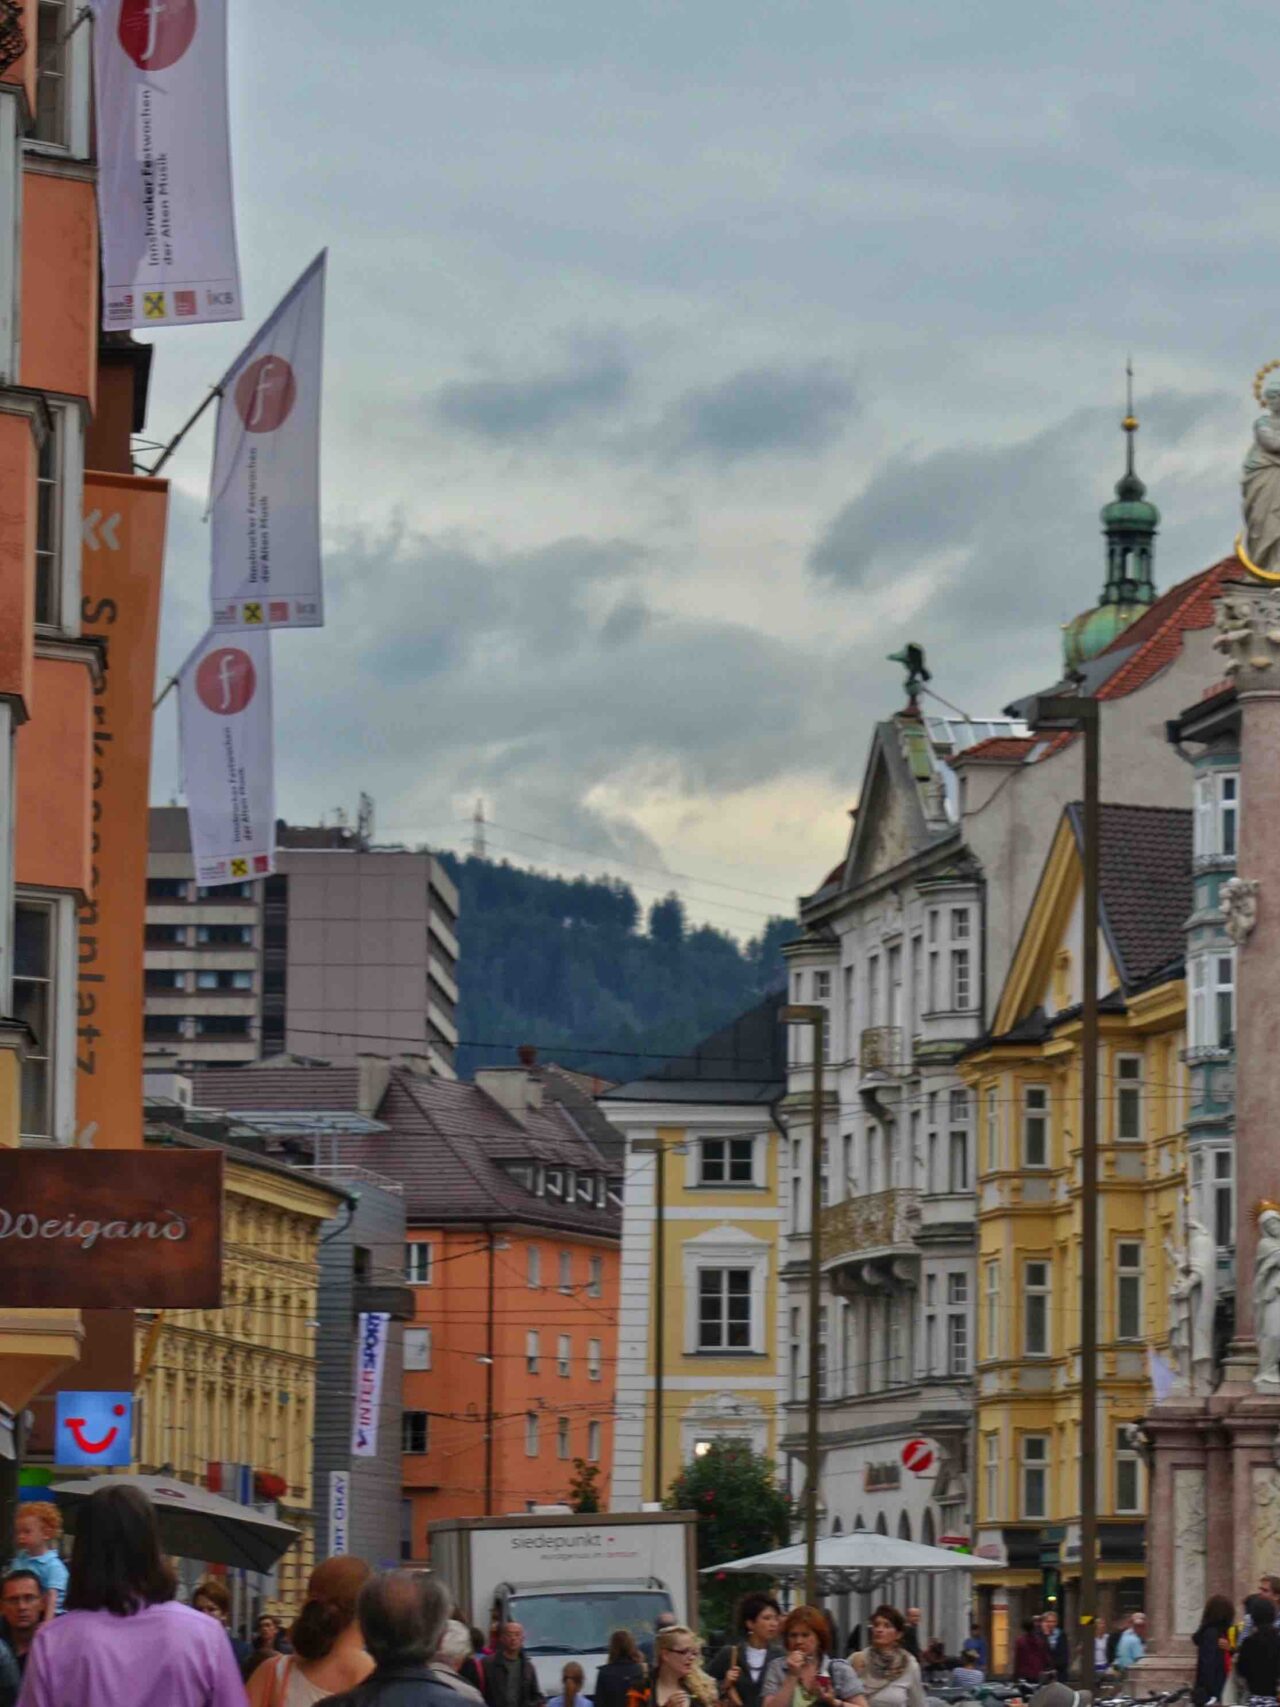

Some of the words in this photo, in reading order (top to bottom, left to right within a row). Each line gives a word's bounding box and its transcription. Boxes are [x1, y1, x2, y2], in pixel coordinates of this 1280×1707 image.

[141, 90, 154, 177] Festwochen
[157, 152, 169, 196] Musik
[143, 181, 160, 267] Innsbrucker
[159, 199, 173, 239] Alten
[161, 242, 174, 267] der
[359, 1313, 381, 1426] INTERSPORT
[333, 1475, 347, 1520] OKAY
[510, 1532, 602, 1551] siedepunkt
